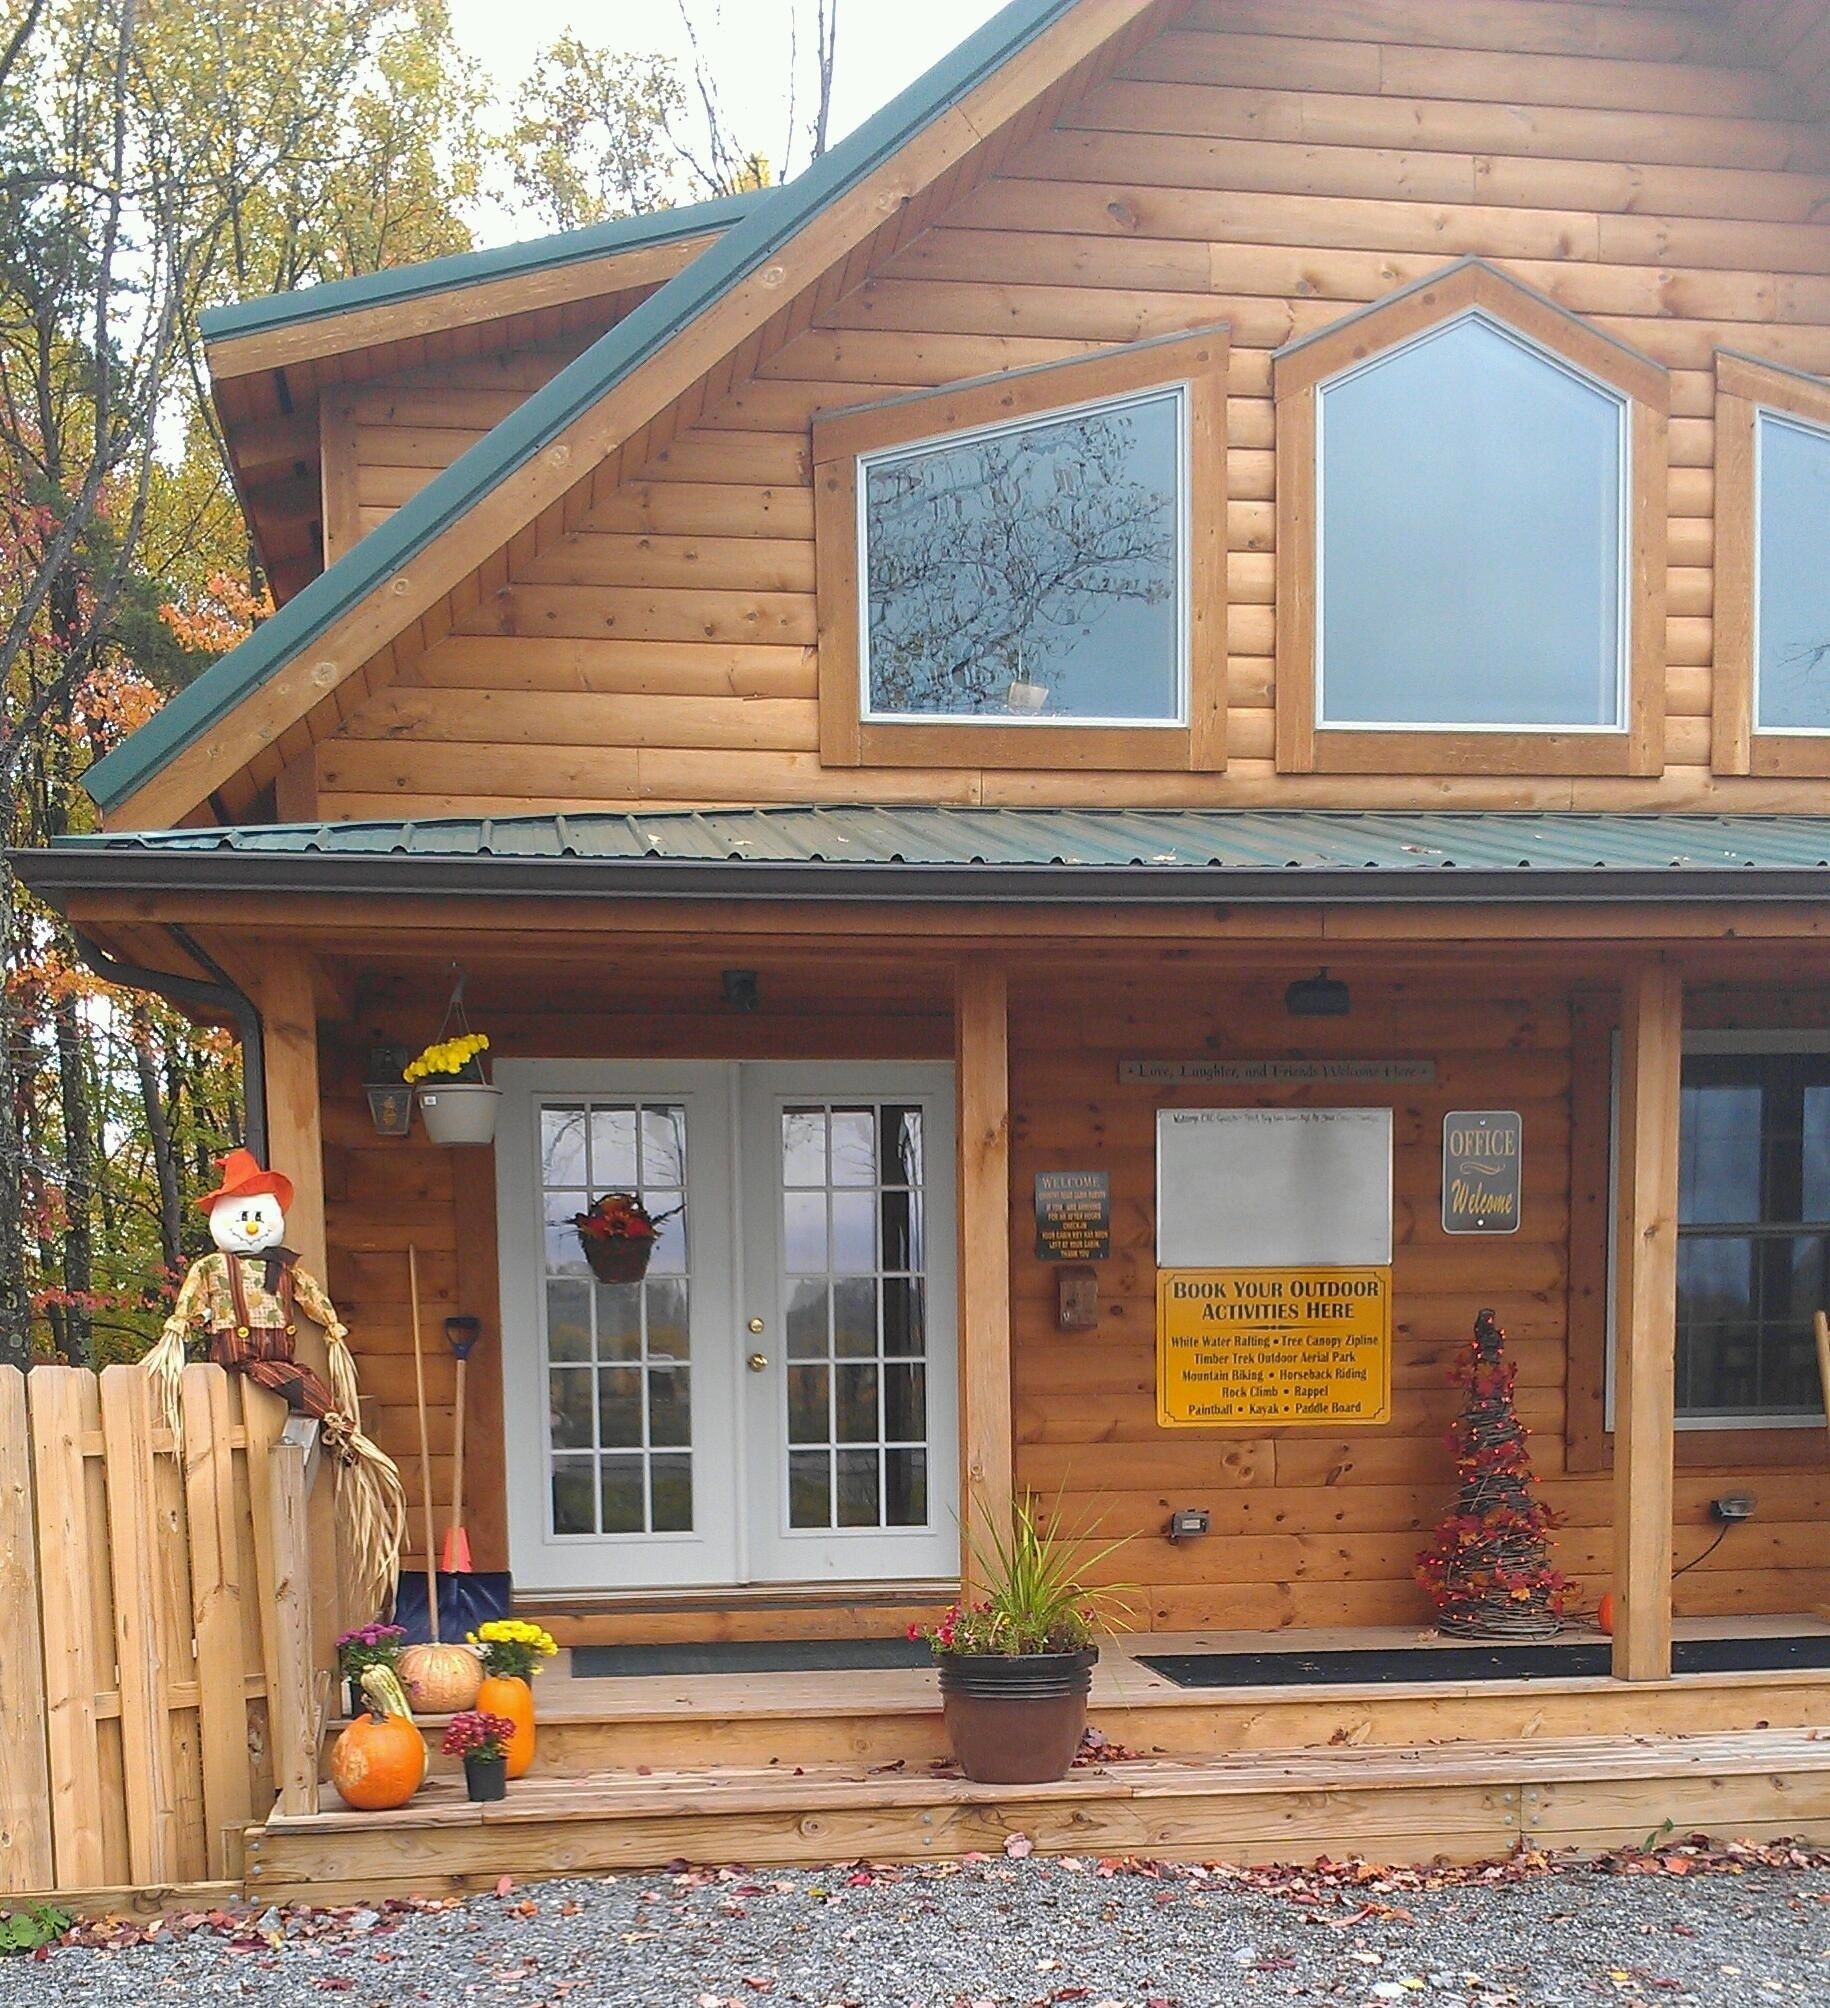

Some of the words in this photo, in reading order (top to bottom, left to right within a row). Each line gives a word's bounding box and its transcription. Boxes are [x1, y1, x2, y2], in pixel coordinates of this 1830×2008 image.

[1138, 1063, 1174, 1080] Love,
[1180, 1063, 1240, 1081] Laughter,
[1244, 1063, 1267, 1078] and
[1273, 1063, 1317, 1078] Friends
[1323, 1062, 1379, 1078] Welcome
[1384, 1063, 1416, 1078] Here
[1449, 1129, 1515, 1157] OFFICE
[1042, 1176, 1099, 1189] WELCOME
[1451, 1178, 1513, 1215] Welcome
[1173, 1282, 1226, 1299] BOOK
[1233, 1281, 1283, 1298] YOUR
[1289, 1280, 1379, 1297] OUTDOOR
[1202, 1303, 1299, 1321] ACTIVITIES
[1306, 1302, 1355, 1319] HERE
[1171, 1336, 1199, 1348] White
[1201, 1336, 1232, 1348] Water
[1233, 1336, 1271, 1349] Rafting
[1282, 1335, 1302, 1346] Tree
[1305, 1335, 1342, 1348] Canopy
[1345, 1335, 1379, 1347] Zipline
[1194, 1353, 1229, 1364] Timber
[1232, 1353, 1254, 1364] Trek
[1257, 1352, 1297, 1364] Outdoor
[1301, 1352, 1329, 1363] Aerial
[1332, 1351, 1356, 1362] Park
[1182, 1369, 1229, 1382] Mountain
[1232, 1369, 1264, 1381] Biking
[1279, 1368, 1333, 1380] Horseback
[1335, 1368, 1367, 1380] Riding
[1221, 1386, 1247, 1398] Rock
[1250, 1386, 1278, 1397] Climb
[1294, 1385, 1329, 1398] Rappel
[1188, 1403, 1233, 1416] Paintball
[1249, 1403, 1279, 1417] Kayak
[1295, 1402, 1329, 1414] Paddle
[1331, 1401, 1361, 1413] Board
